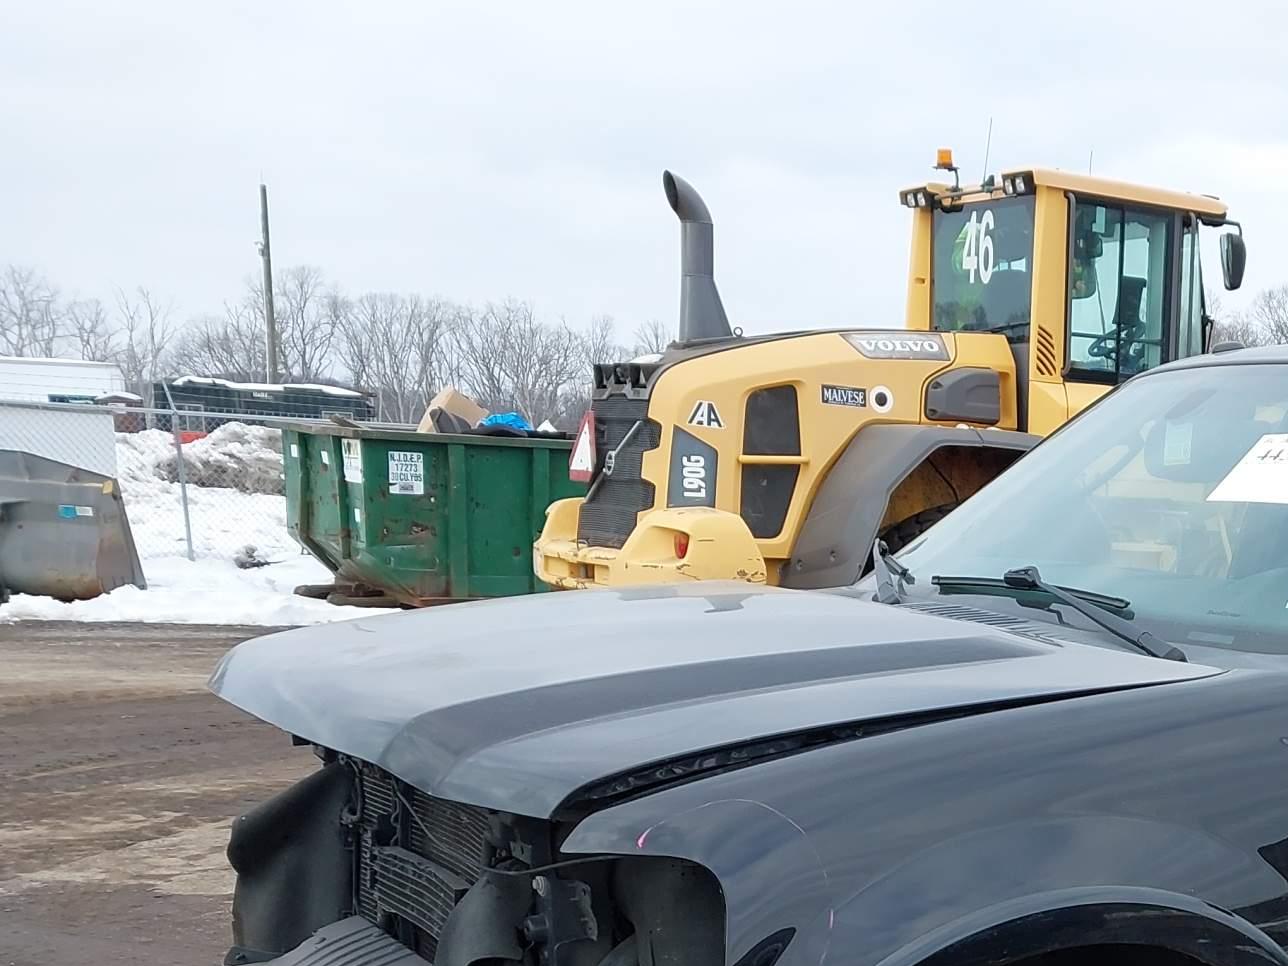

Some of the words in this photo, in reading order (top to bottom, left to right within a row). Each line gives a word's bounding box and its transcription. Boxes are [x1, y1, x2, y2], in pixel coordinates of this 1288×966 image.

[963, 210, 994, 284] 46
[858, 340, 939, 352] VOLVO
[823, 387, 865, 404] MALVESE
[395, 464, 418, 473] 17273
[682, 455, 706, 497] L90G
